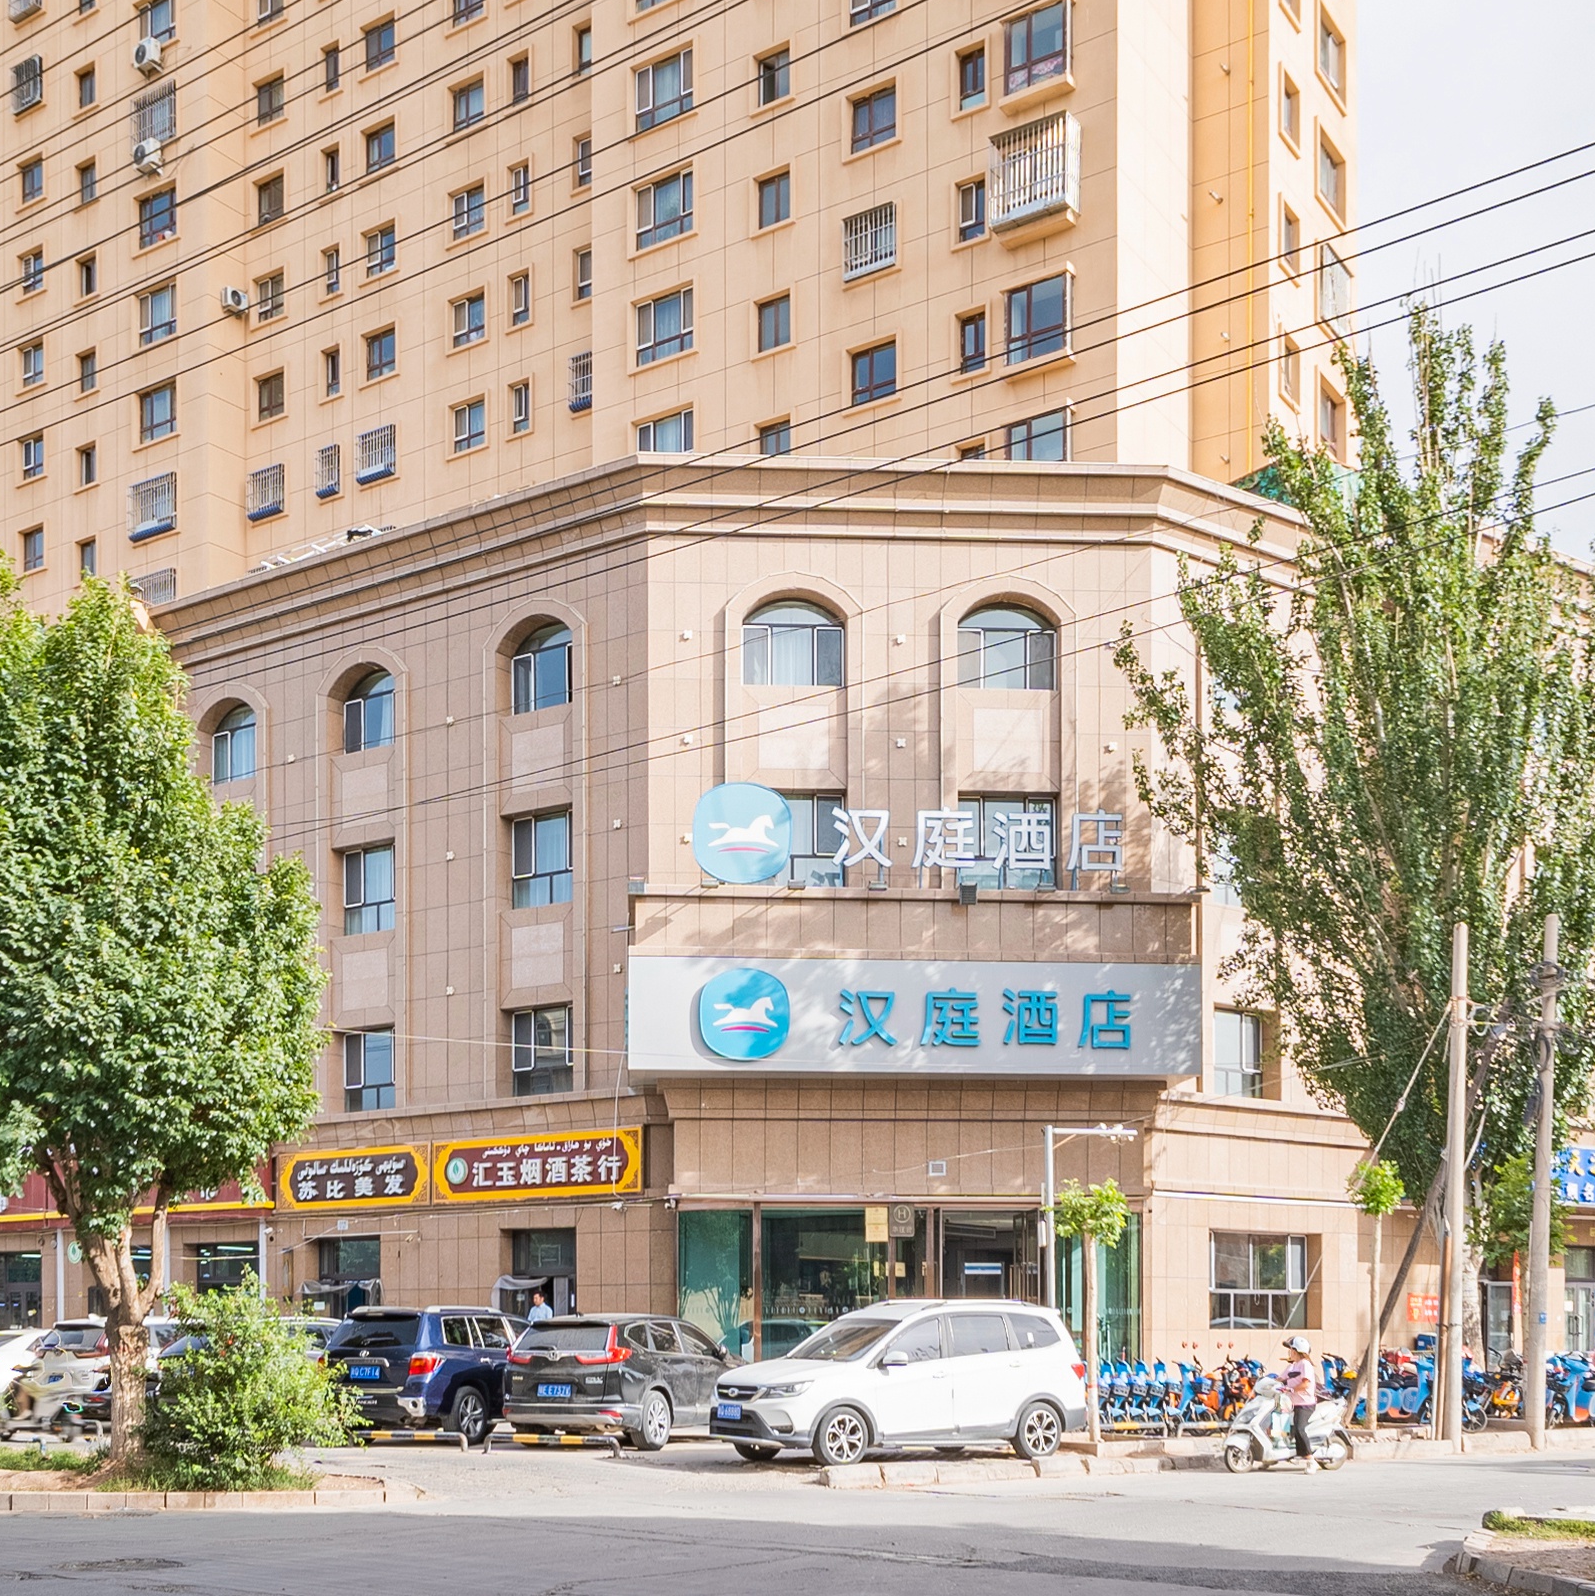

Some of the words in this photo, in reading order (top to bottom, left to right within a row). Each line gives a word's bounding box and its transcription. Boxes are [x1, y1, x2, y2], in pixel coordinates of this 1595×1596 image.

[831, 806, 1123, 871] 汉庭酒店
[838, 987, 1132, 1049] 汉庭酒店
[297, 1174, 406, 1201] 苏比美发
[472, 1155, 624, 1188] 汇玉烟酒茶行
